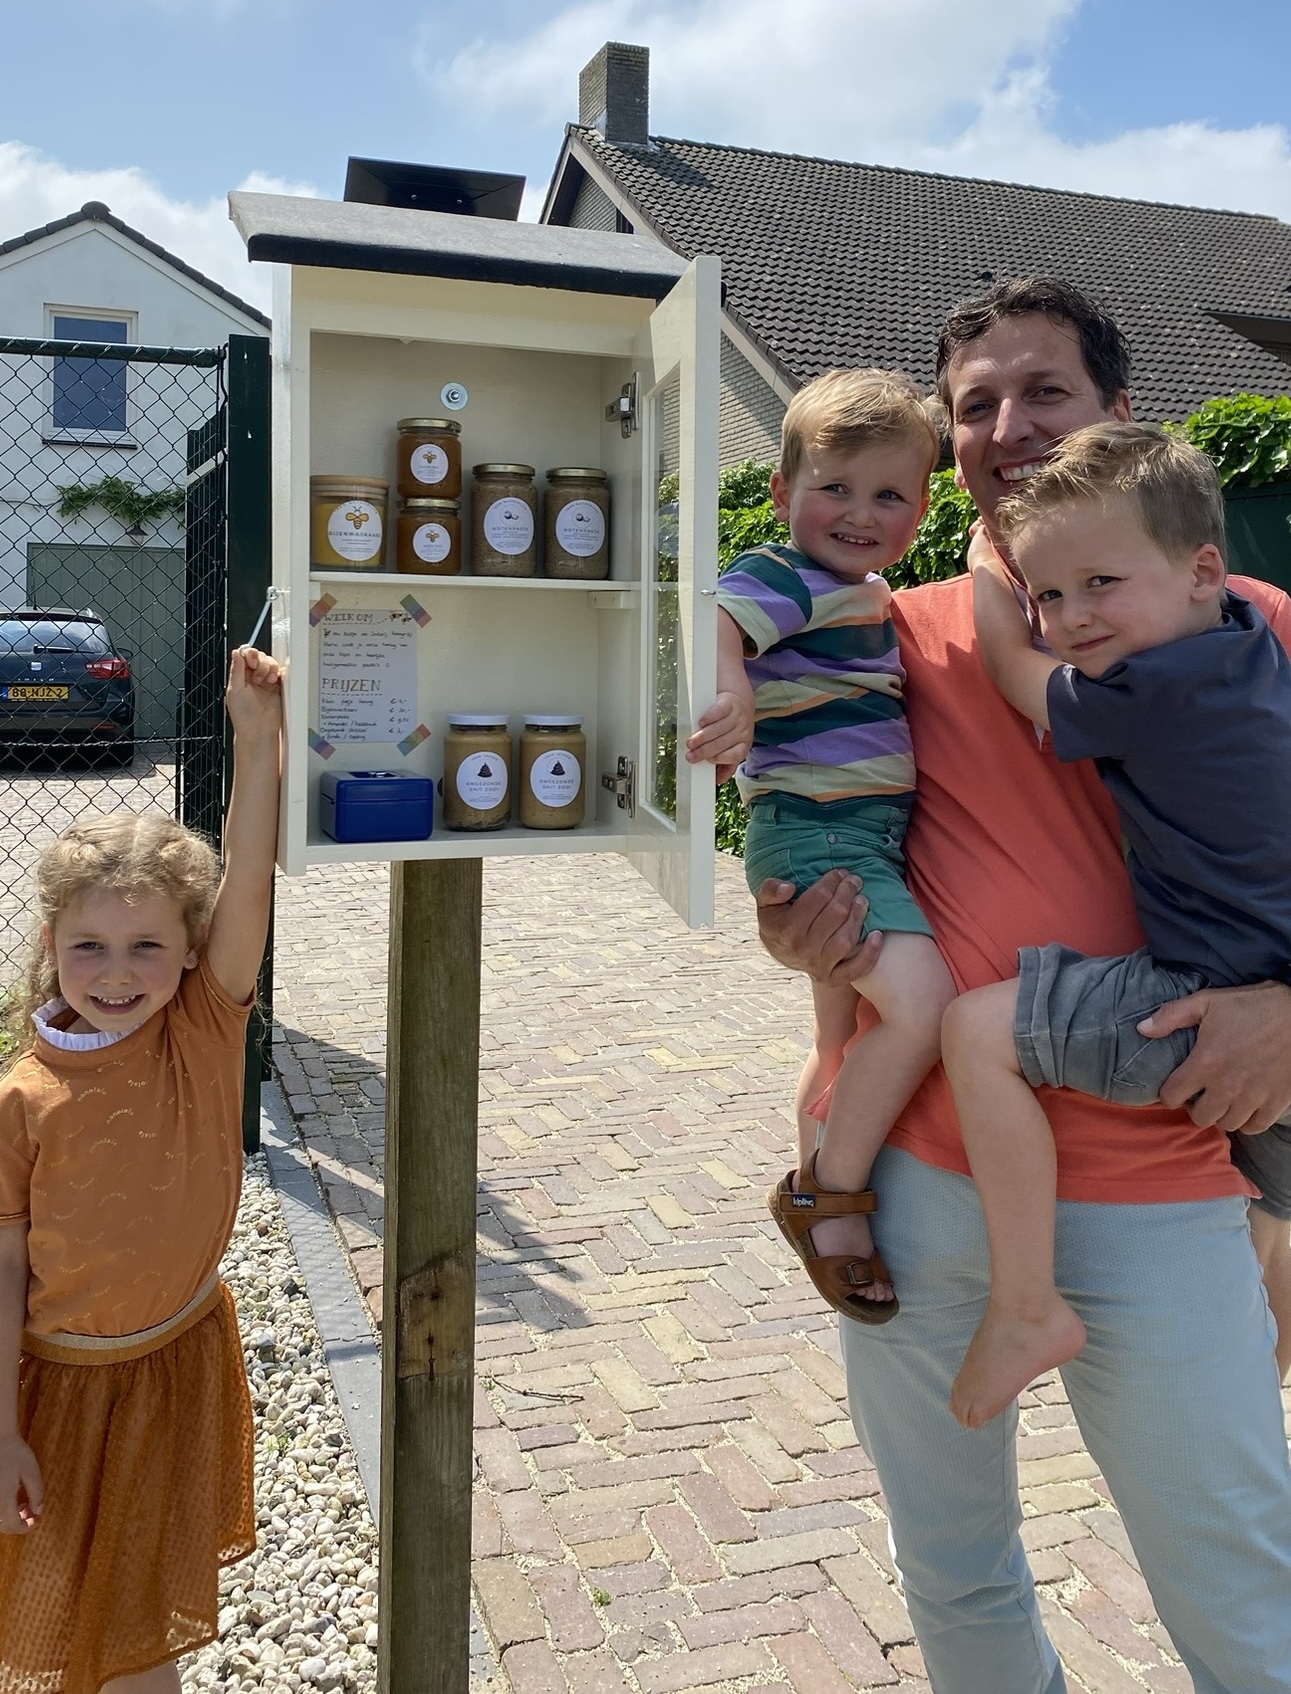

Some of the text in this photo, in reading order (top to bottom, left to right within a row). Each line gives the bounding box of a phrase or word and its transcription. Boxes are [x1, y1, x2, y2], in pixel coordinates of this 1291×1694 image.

[324, 613, 373, 622] WELKOM
[321, 677, 382, 693] PRIJZEN
[12, 688, 63, 697] 88-NJZ2
[793, 1197, 814, 1207] kipling
